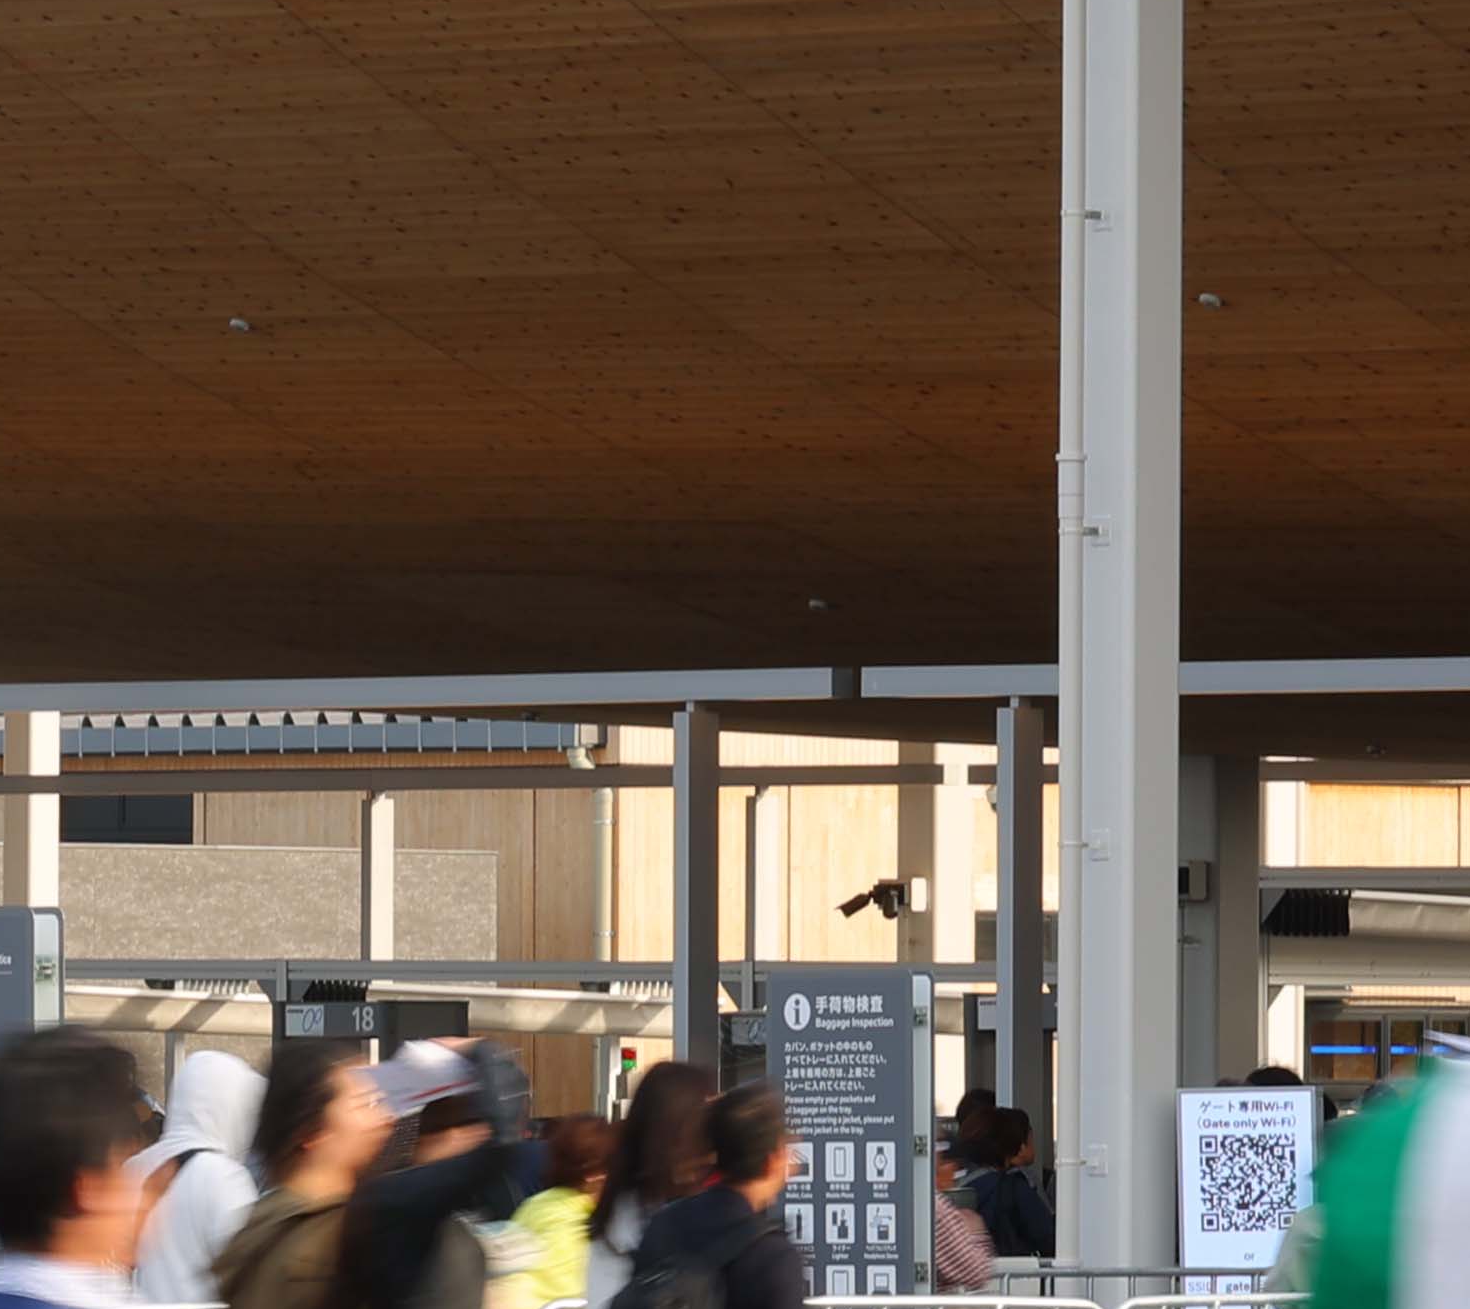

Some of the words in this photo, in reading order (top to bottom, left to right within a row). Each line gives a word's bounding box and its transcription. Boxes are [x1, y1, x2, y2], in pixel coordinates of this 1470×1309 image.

[815, 995, 883, 1014] 手荷物検査
[352, 1006, 374, 1032] 18
[815, 1017, 850, 1030] Baggage
[851, 1016, 894, 1029] Inspection
[864, 1093, 876, 1103] and
[1233, 1117, 1258, 1130] only
